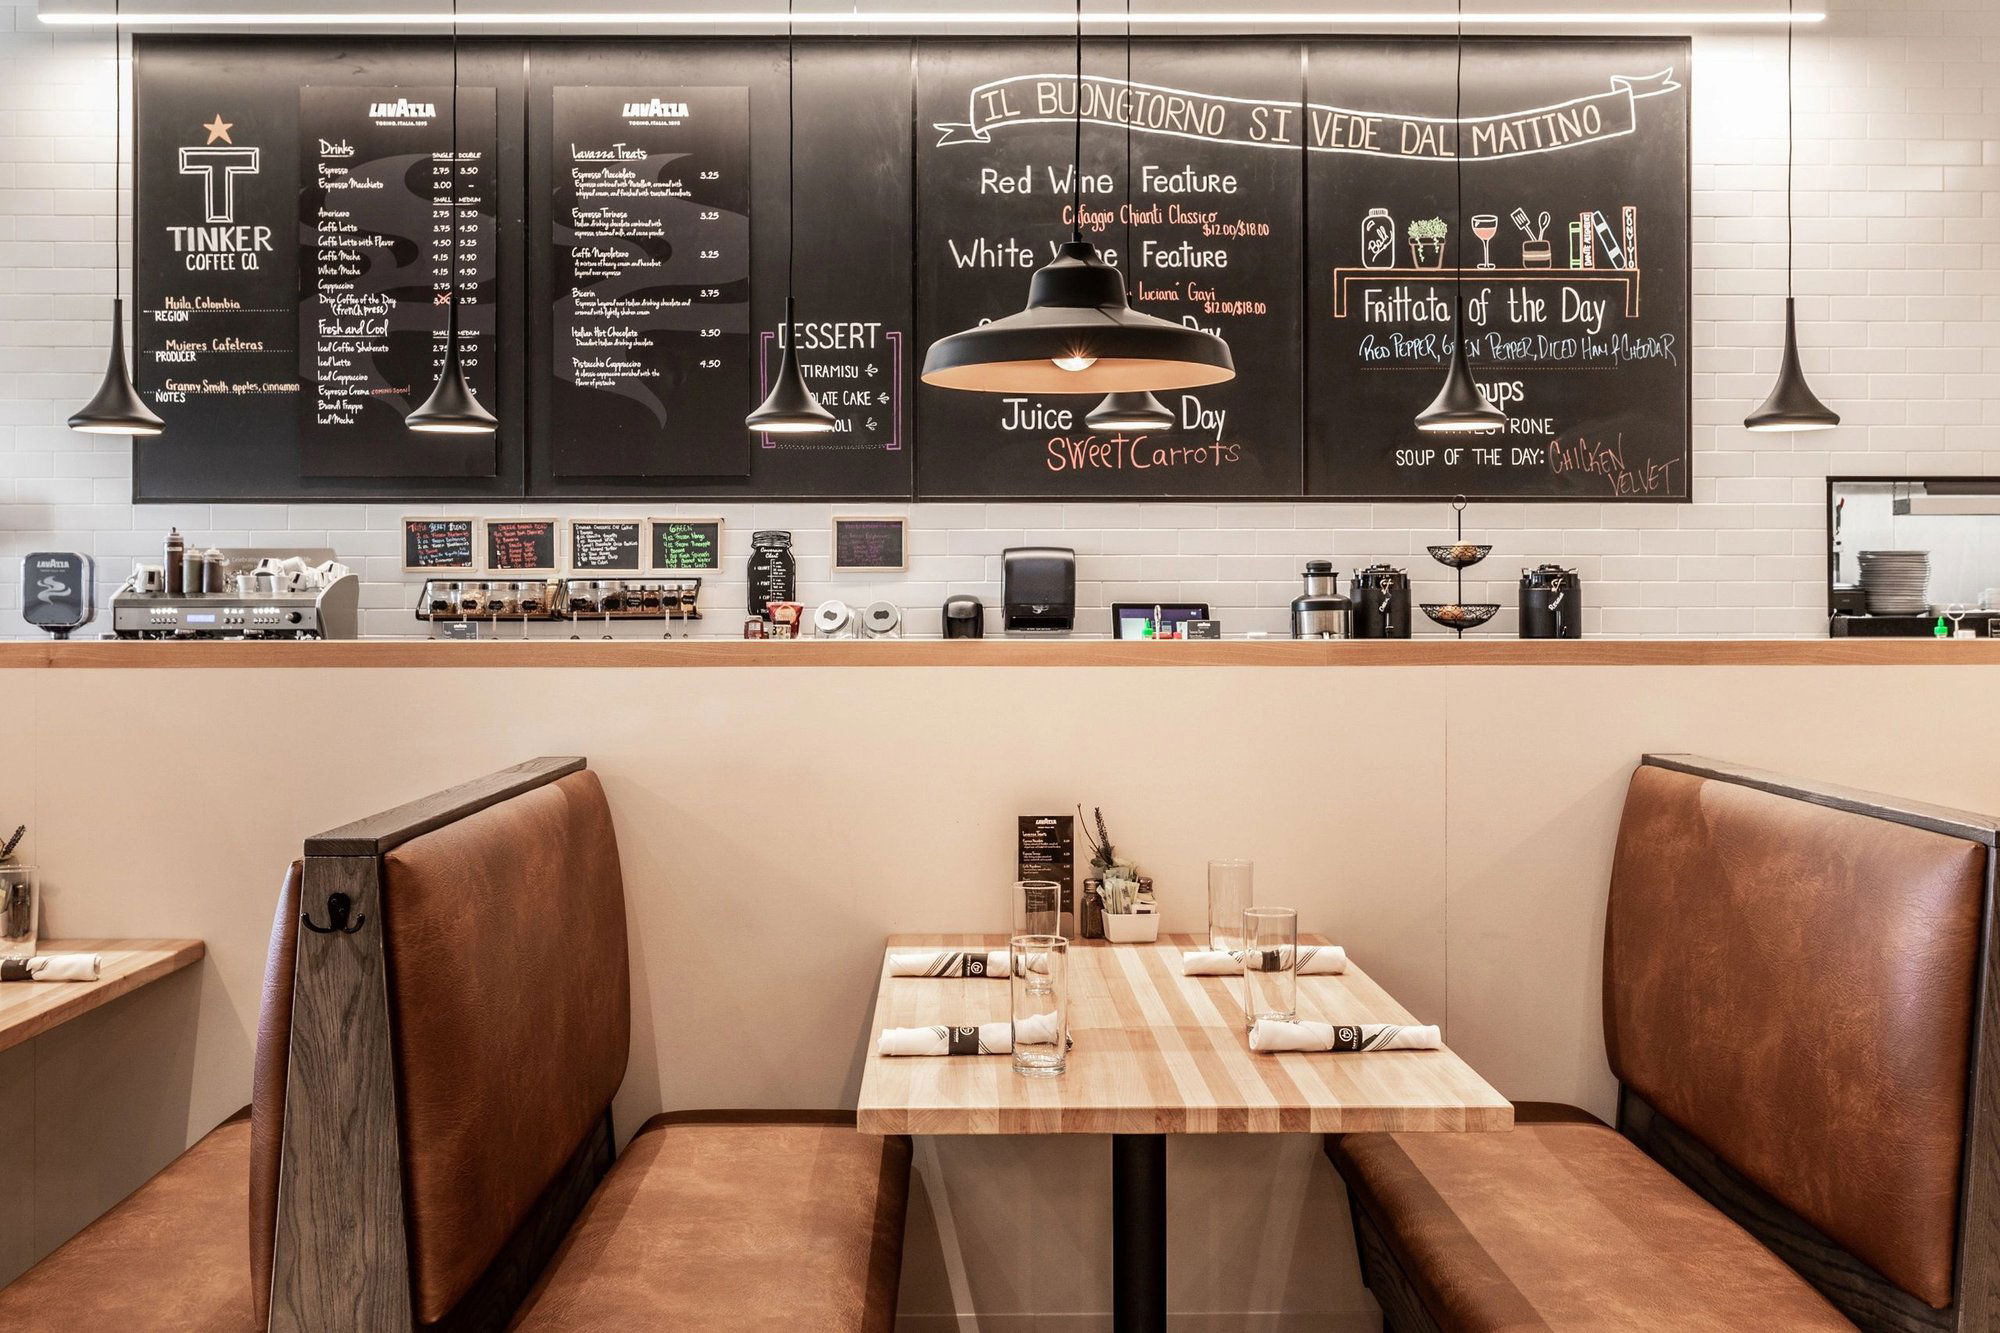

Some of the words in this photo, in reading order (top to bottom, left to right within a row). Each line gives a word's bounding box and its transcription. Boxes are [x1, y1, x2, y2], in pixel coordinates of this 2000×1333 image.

[369, 98, 436, 117] LAVAZZA
[622, 98, 689, 117] LAVAZZA
[980, 89, 1020, 121] IL
[1037, 82, 1225, 136] BUONGIORNO
[1250, 107, 1292, 143] SI
[1312, 111, 1382, 151] VEDE
[1400, 121, 1455, 156] DAL
[1472, 105, 1601, 156] MATTINO
[318, 138, 355, 156] Drinks
[571, 143, 615, 160] Lavazza
[613, 143, 648, 160] Treats
[318, 163, 348, 178] Espresso
[432, 167, 450, 175] 2.75
[460, 167, 478, 175] 3.50
[572, 168, 601, 183] Espresso
[700, 172, 719, 180] 3.25
[318, 178, 348, 192] Espresso
[349, 178, 384, 189] Macchiato
[433, 181, 452, 189] 3.00
[980, 166, 1032, 195] Red
[1047, 164, 1114, 194] Wine
[1142, 165, 1237, 194] Feature
[318, 207, 350, 218] Americano
[572, 208, 601, 223] Espresso
[600, 207, 628, 218] Torinese
[700, 212, 719, 220] 3.25
[1120, 204, 1162, 226] Chianti
[1169, 204, 1218, 224] Classico
[339, 221, 358, 232] Latte
[166, 226, 273, 252] TINKER
[339, 235, 358, 246] Latte
[358, 235, 373, 246] with
[375, 235, 395, 247] Flavor
[432, 239, 451, 247] 4.50
[459, 239, 477, 247] 5.25
[1368, 226, 1389, 254] Ball
[338, 250, 361, 261] Mocha
[700, 251, 719, 259] 3.25
[948, 237, 1034, 268] White
[1142, 241, 1228, 268] Feature
[186, 253, 235, 271] COFFEE
[241, 253, 259, 270] CO.
[318, 264, 338, 275] White
[338, 264, 361, 275] Mocha
[318, 279, 354, 294] Cappuccino
[571, 287, 596, 298] Bicerin
[700, 289, 720, 298] 3.75
[1188, 282, 1216, 301] Gavi
[195, 297, 241, 310] Colombia
[319, 294, 335, 308] Drip
[336, 294, 358, 305] Coffee
[358, 294, 367, 305] of
[368, 294, 380, 304] the
[382, 294, 397, 308] Day
[155, 311, 189, 322] REGION
[1364, 286, 1451, 323] Frittata
[1468, 288, 1492, 326] of
[1507, 286, 1547, 323] the
[1562, 286, 1606, 335] Day
[318, 319, 343, 335] Fresh
[345, 320, 365, 335] and
[366, 319, 389, 336] Cool
[571, 327, 593, 338] Italian
[594, 327, 606, 338] Hot
[607, 326, 638, 338] Chocolate
[700, 329, 720, 337] 3.50
[166, 340, 207, 352] Mujeres
[212, 338, 264, 350] Cafeteras
[318, 341, 332, 352] Iced
[333, 341, 355, 352] Coffee
[1359, 334, 1391, 361] RED
[1537, 335, 1577, 360] DICED
[155, 351, 197, 362] PRODUCER
[318, 355, 332, 366] Iced
[333, 356, 351, 366] Latte
[606, 357, 641, 373] Cappuccino
[700, 360, 721, 368] 4.50
[801, 364, 858, 378] TIRAMISU
[318, 370, 332, 381] Iced
[333, 370, 368, 385] Cappuccino
[166, 379, 201, 393] Granny
[202, 379, 229, 392] Smith
[262, 382, 300, 392] cinnamon
[318, 385, 348, 400] Espresso
[349, 385, 370, 395] Crema
[155, 391, 186, 403] NOTES
[843, 391, 872, 406] CAKE
[318, 414, 331, 424] Iced
[331, 413, 354, 424] Mocha
[1001, 399, 1073, 431] Juice
[1182, 395, 1226, 441] Day
[1131, 435, 1241, 467] Carrots
[1395, 450, 1435, 466] SOUP
[1444, 448, 1464, 465] OF
[1472, 448, 1503, 466] THE
[1511, 448, 1545, 466] DAY:
[1549, 433, 1626, 475] CHICKEN
[1608, 458, 1680, 497] VELVET
[36, 558, 70, 569] LAVAZZA
